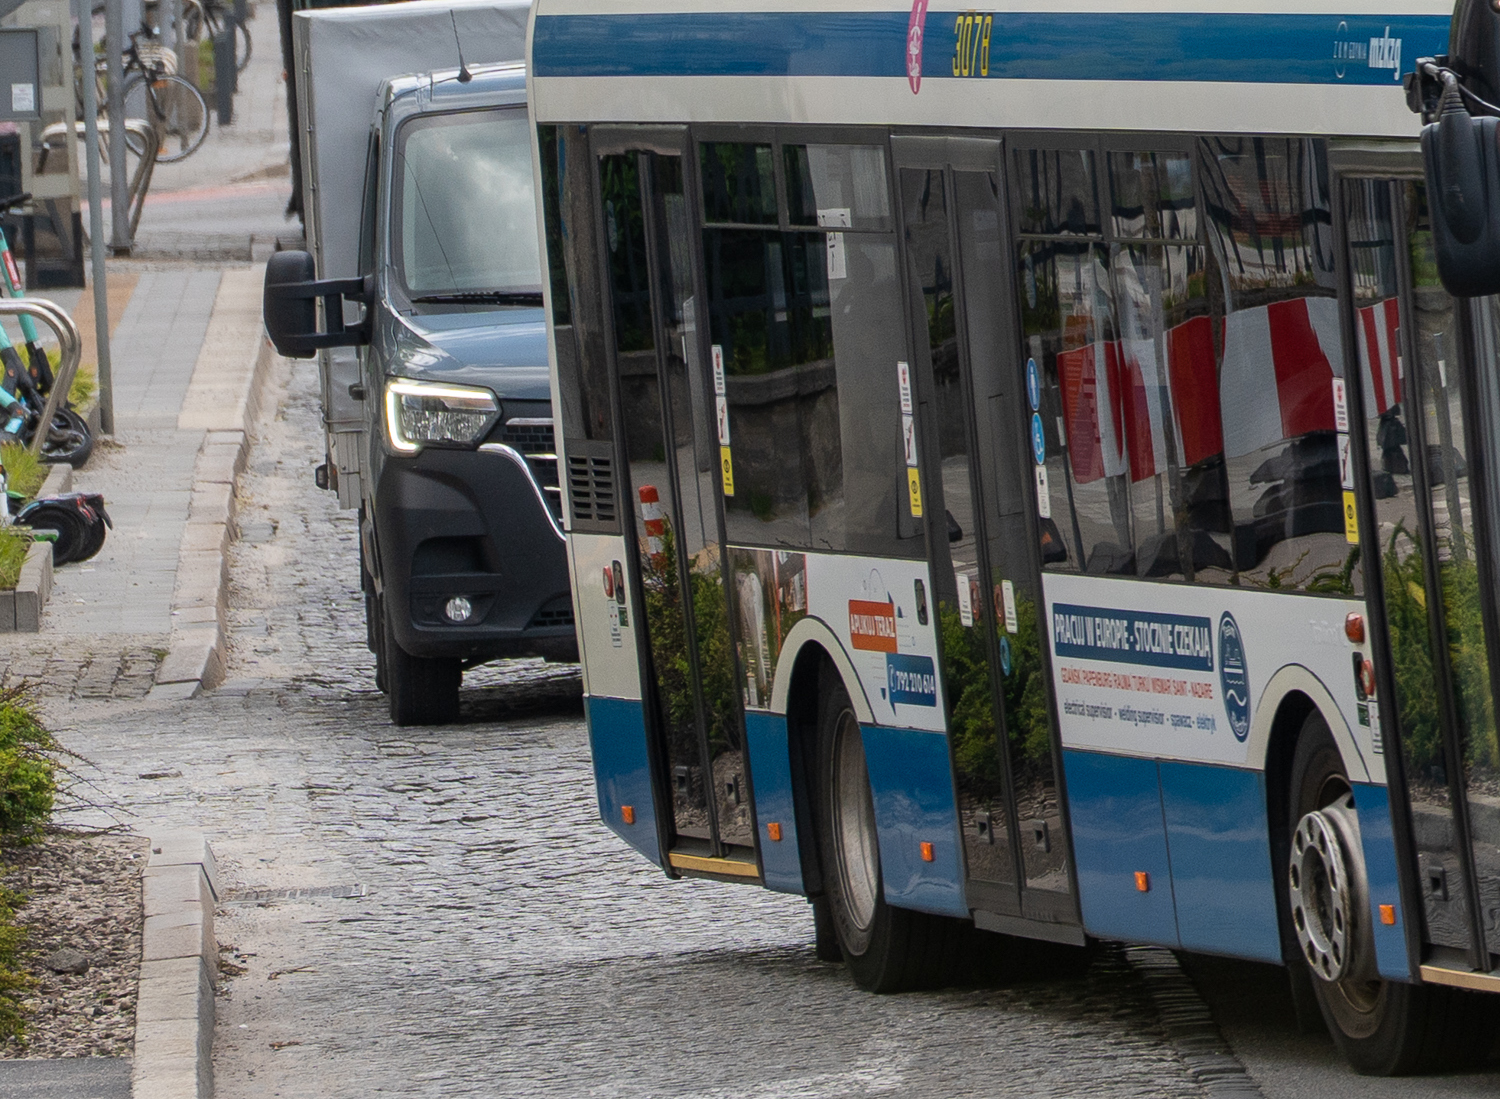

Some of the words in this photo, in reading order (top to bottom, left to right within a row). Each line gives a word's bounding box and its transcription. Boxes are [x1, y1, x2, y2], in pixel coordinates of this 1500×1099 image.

[952, 13, 993, 78] 3078
[850, 613, 876, 636] APLIKUJ
[875, 615, 896, 638] TERAZ
[1054, 613, 1085, 645] PRACUJ
[1085, 616, 1096, 647] W
[1096, 617, 1129, 650] EUROPIE
[1133, 621, 1174, 654] STOCZNIE
[1174, 624, 1213, 667] CZEKAJĄ
[896, 670, 910, 692] 792
[909, 673, 922, 693] 210
